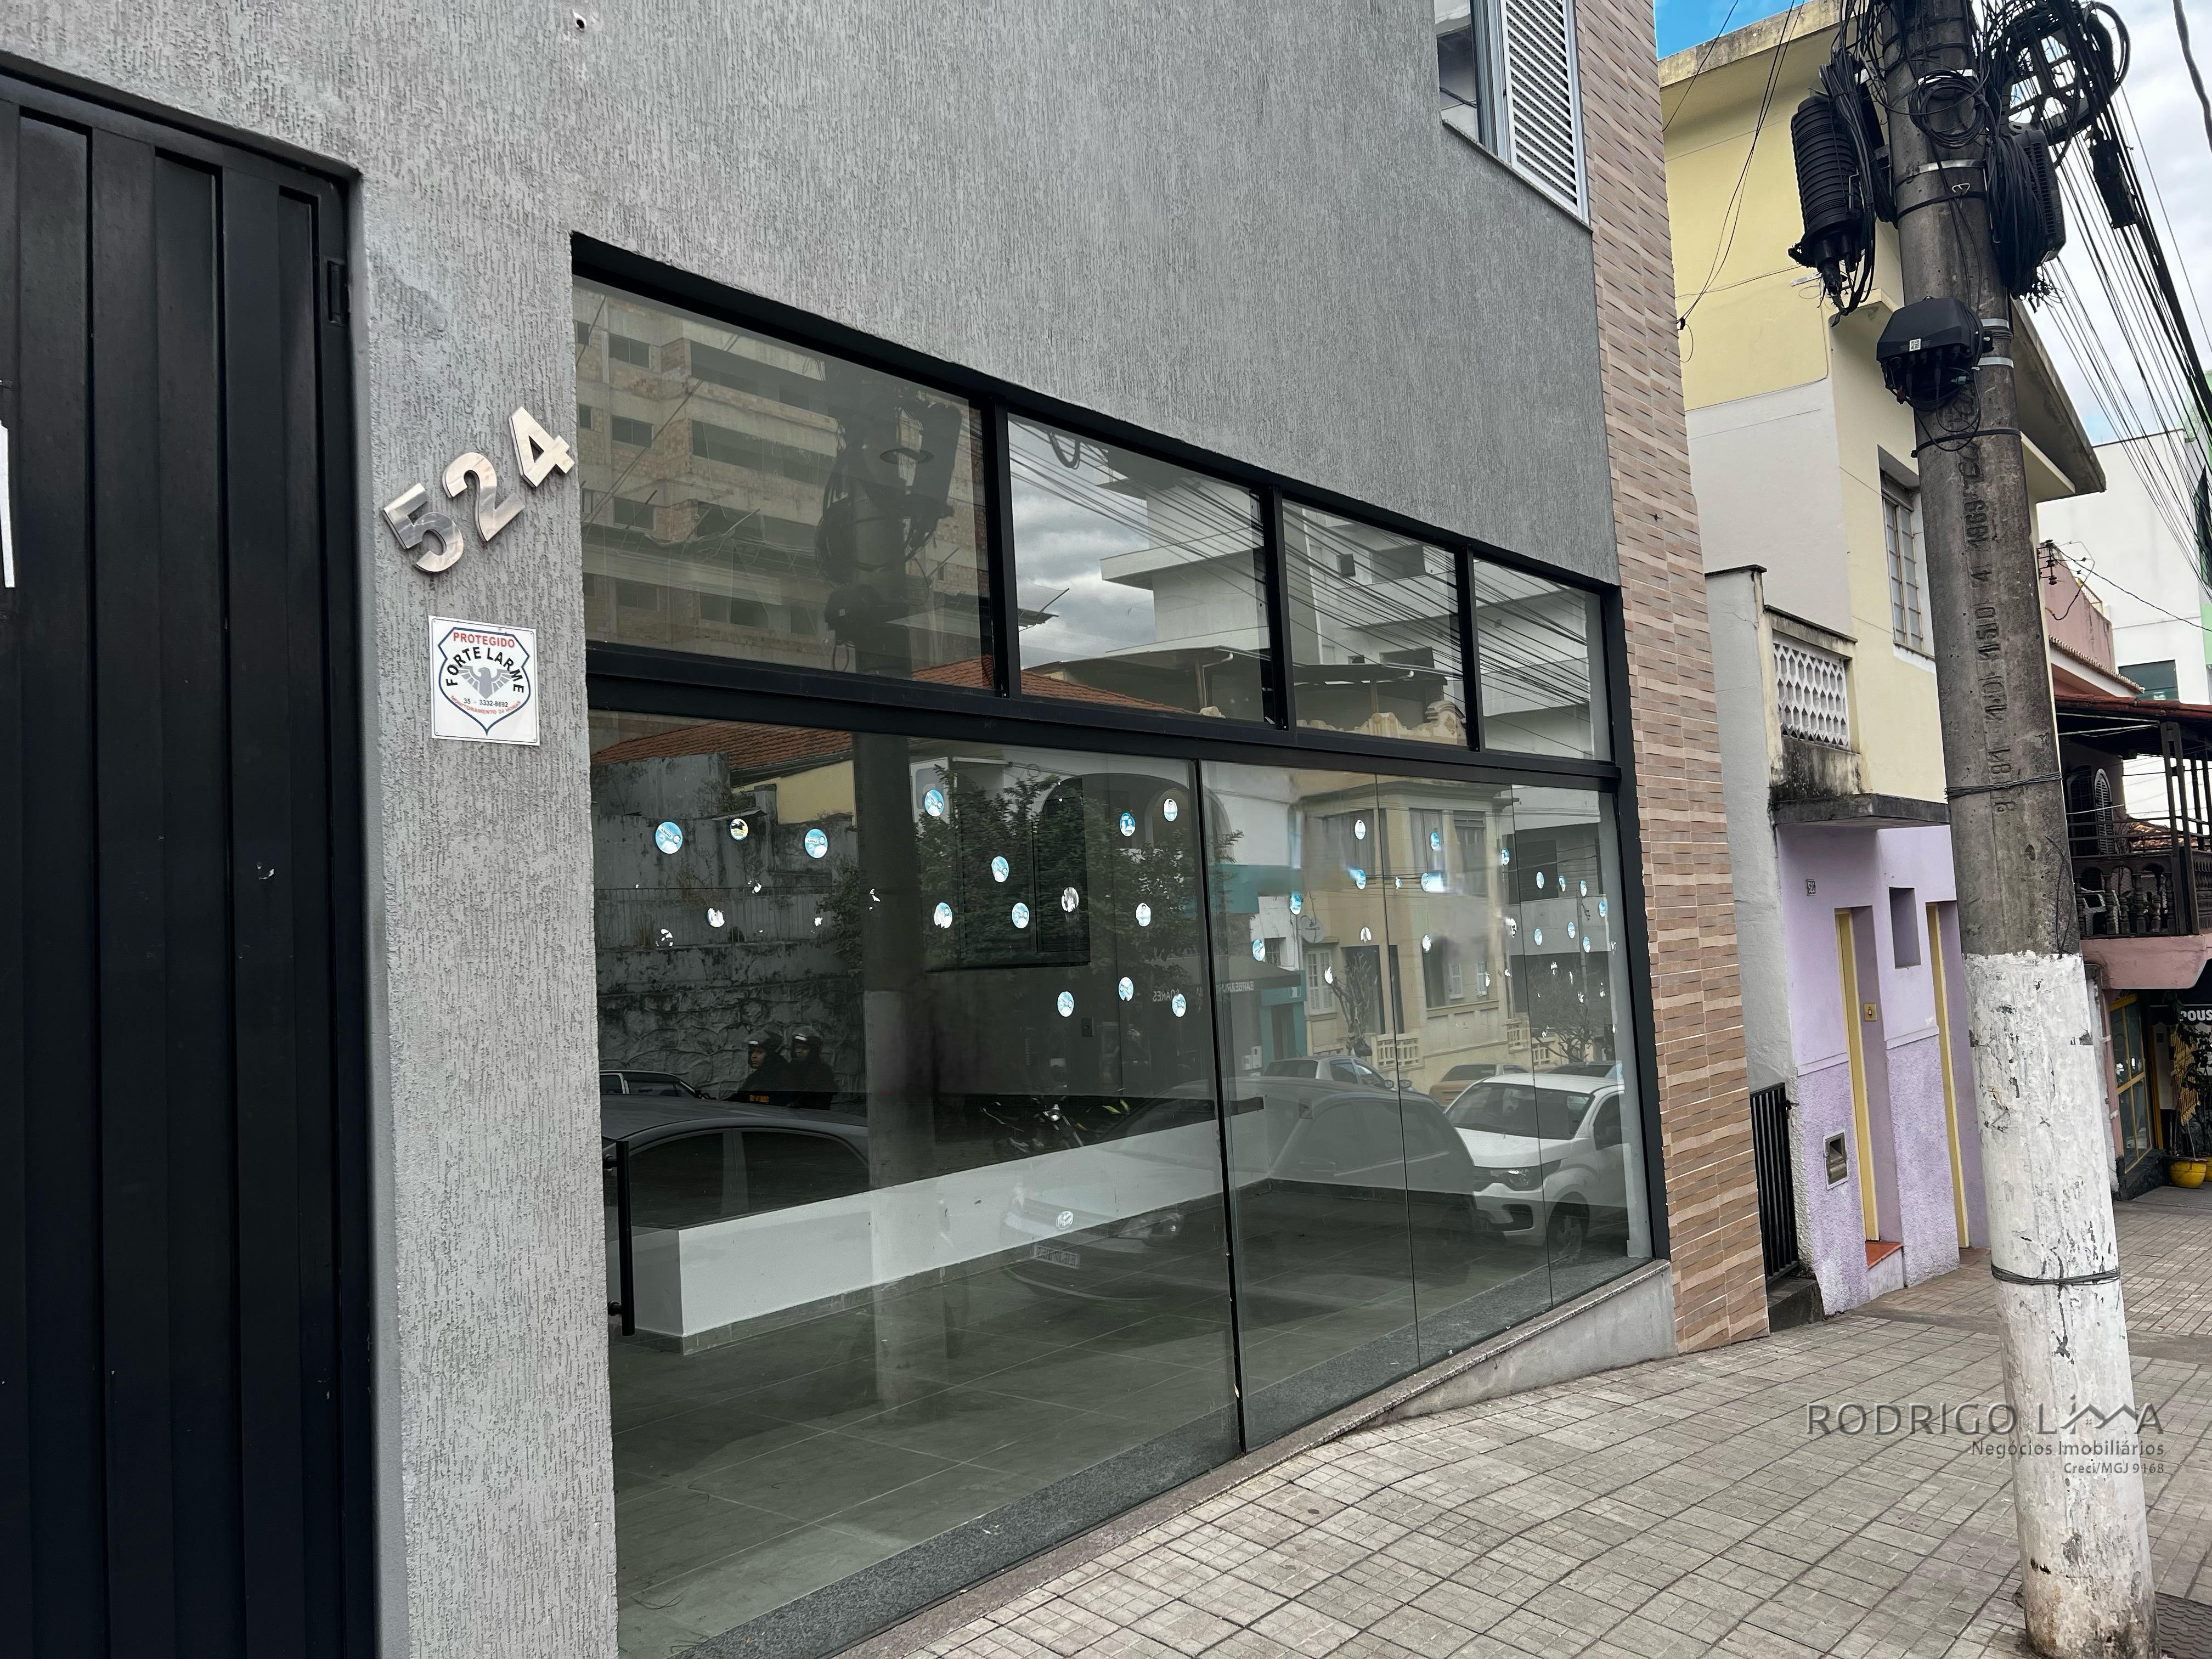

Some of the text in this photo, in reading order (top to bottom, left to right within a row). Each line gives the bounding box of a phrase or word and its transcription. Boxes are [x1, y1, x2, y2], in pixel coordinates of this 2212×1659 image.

[383, 405, 575, 573] 524
[453, 631, 515, 648] PROTEGIDO
[445, 646, 524, 693] FORTE LARME
